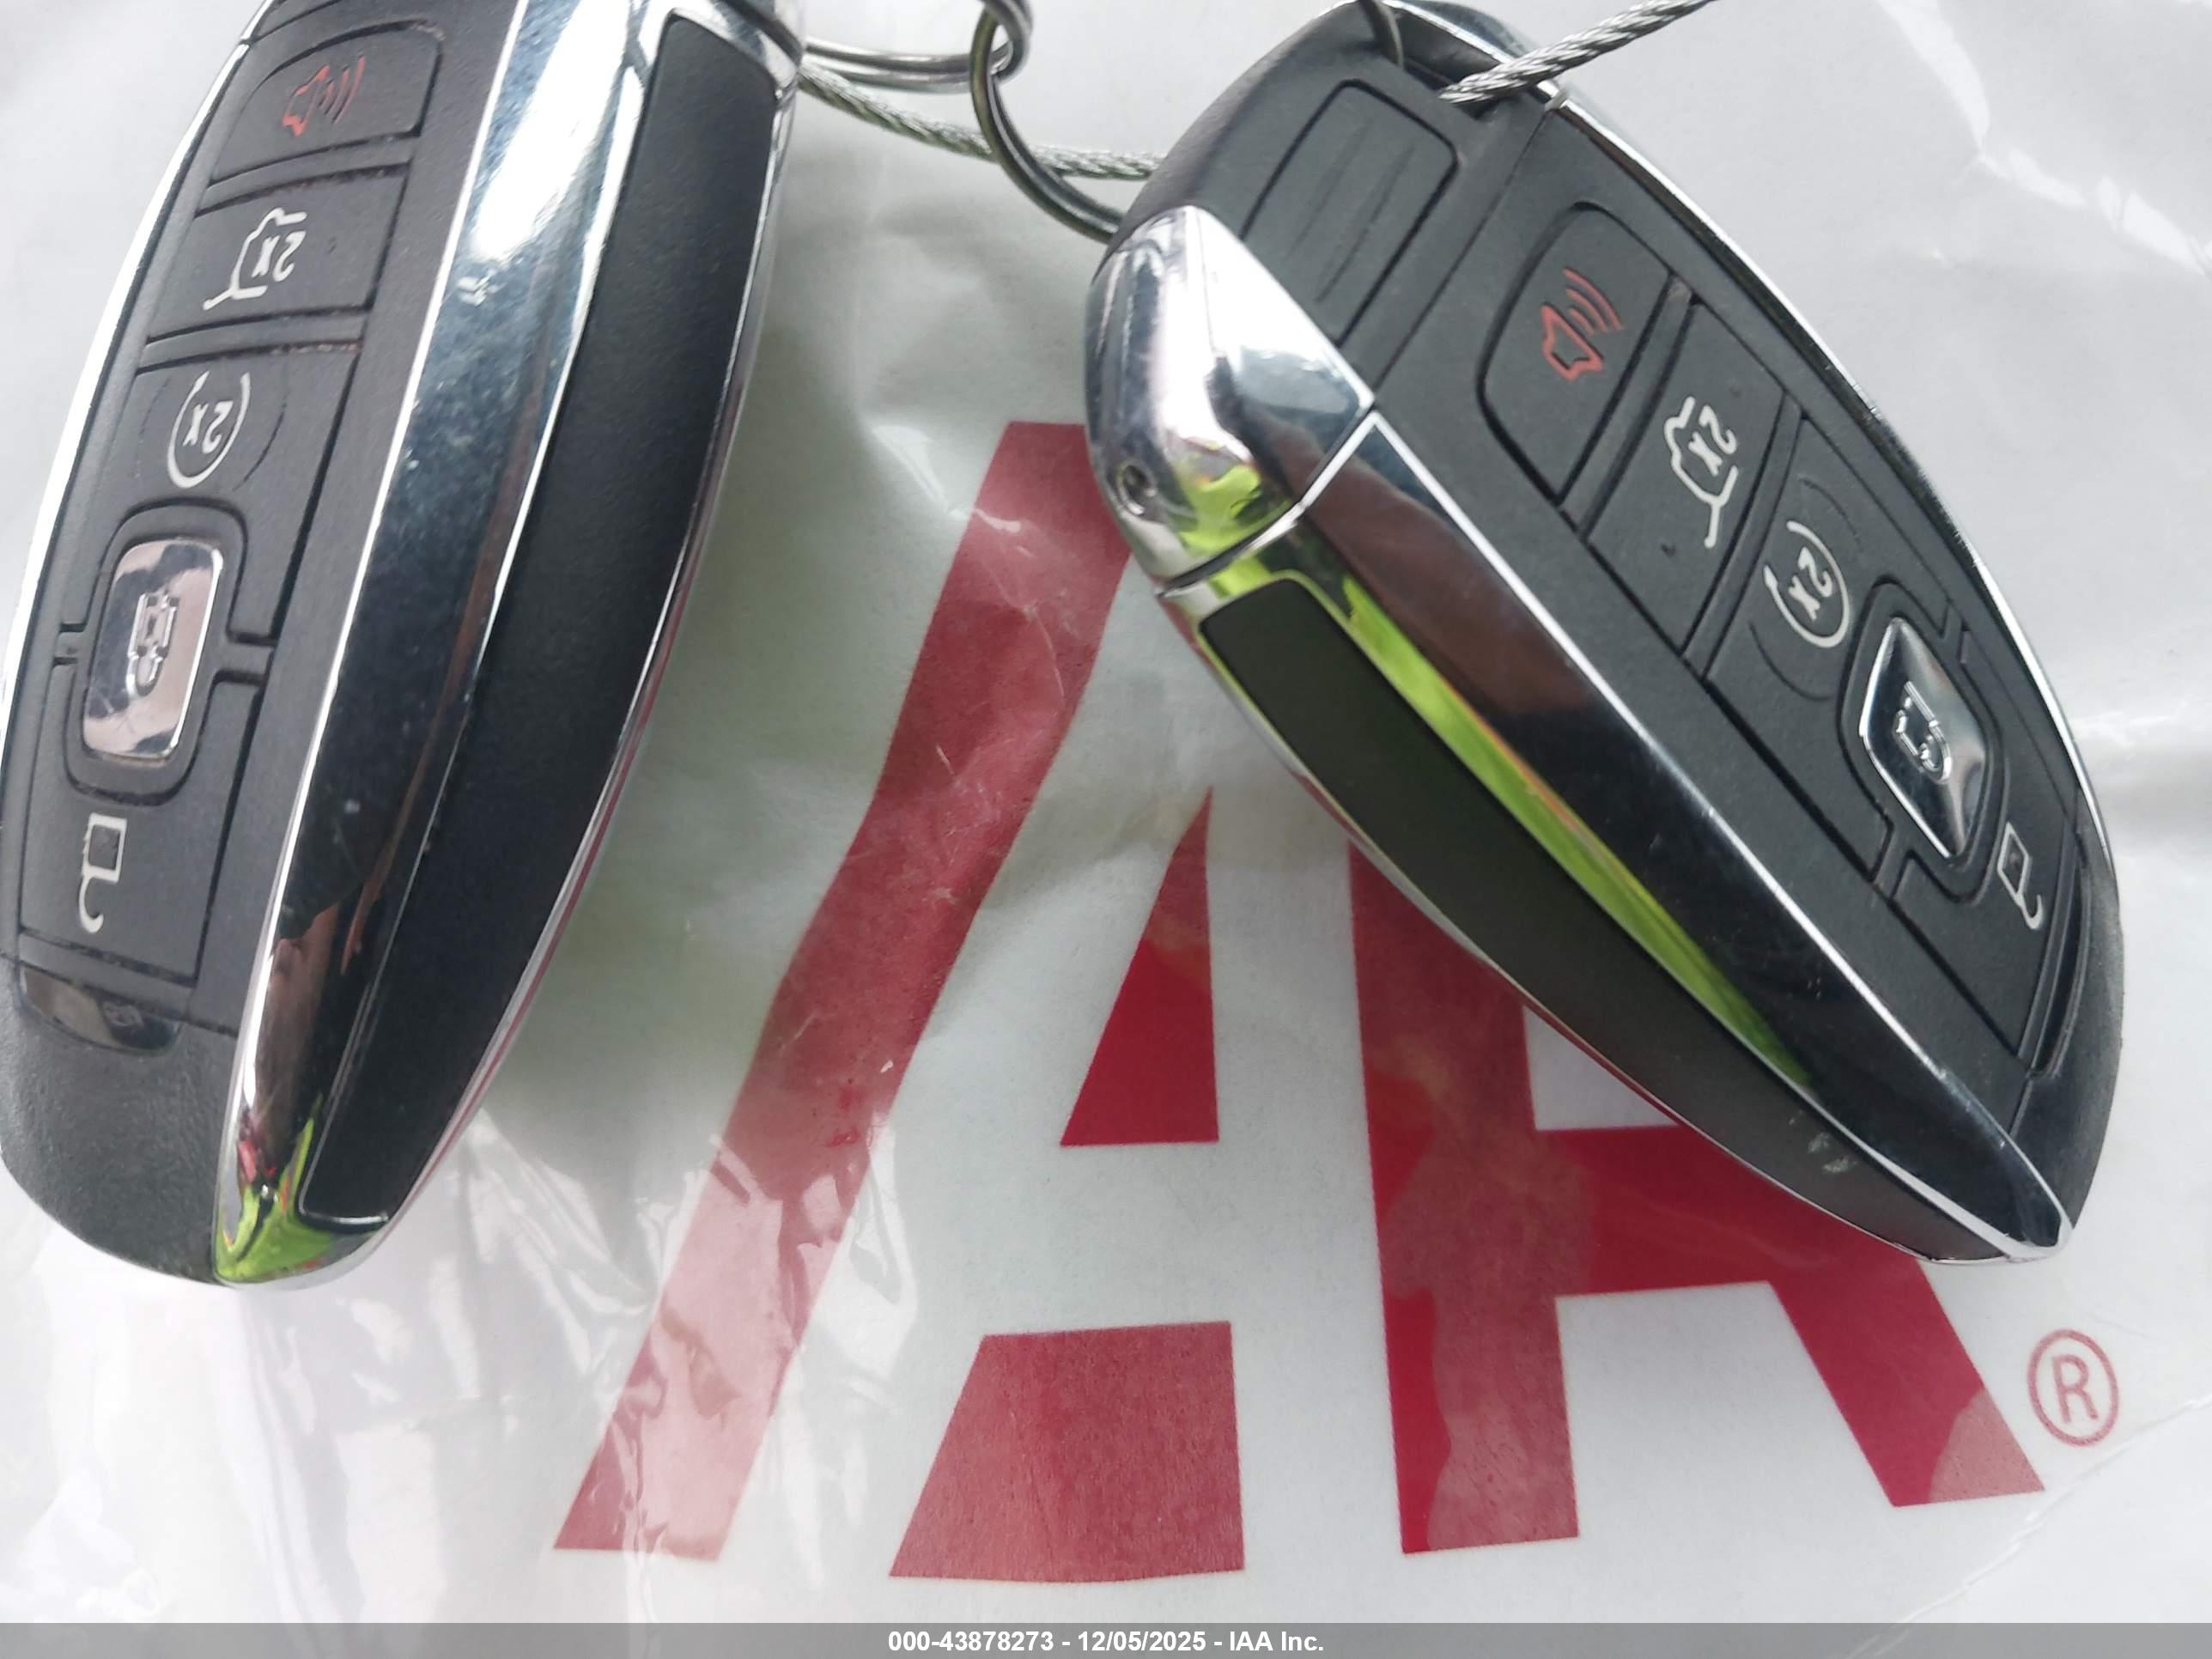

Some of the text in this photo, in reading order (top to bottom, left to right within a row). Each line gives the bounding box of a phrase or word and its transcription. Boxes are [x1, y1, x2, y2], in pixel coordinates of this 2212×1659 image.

[251, 229, 307, 282] 2x
[182, 400, 234, 454] 2x
[1687, 404, 1737, 477] 2x
[1787, 546, 1833, 622] 2x
